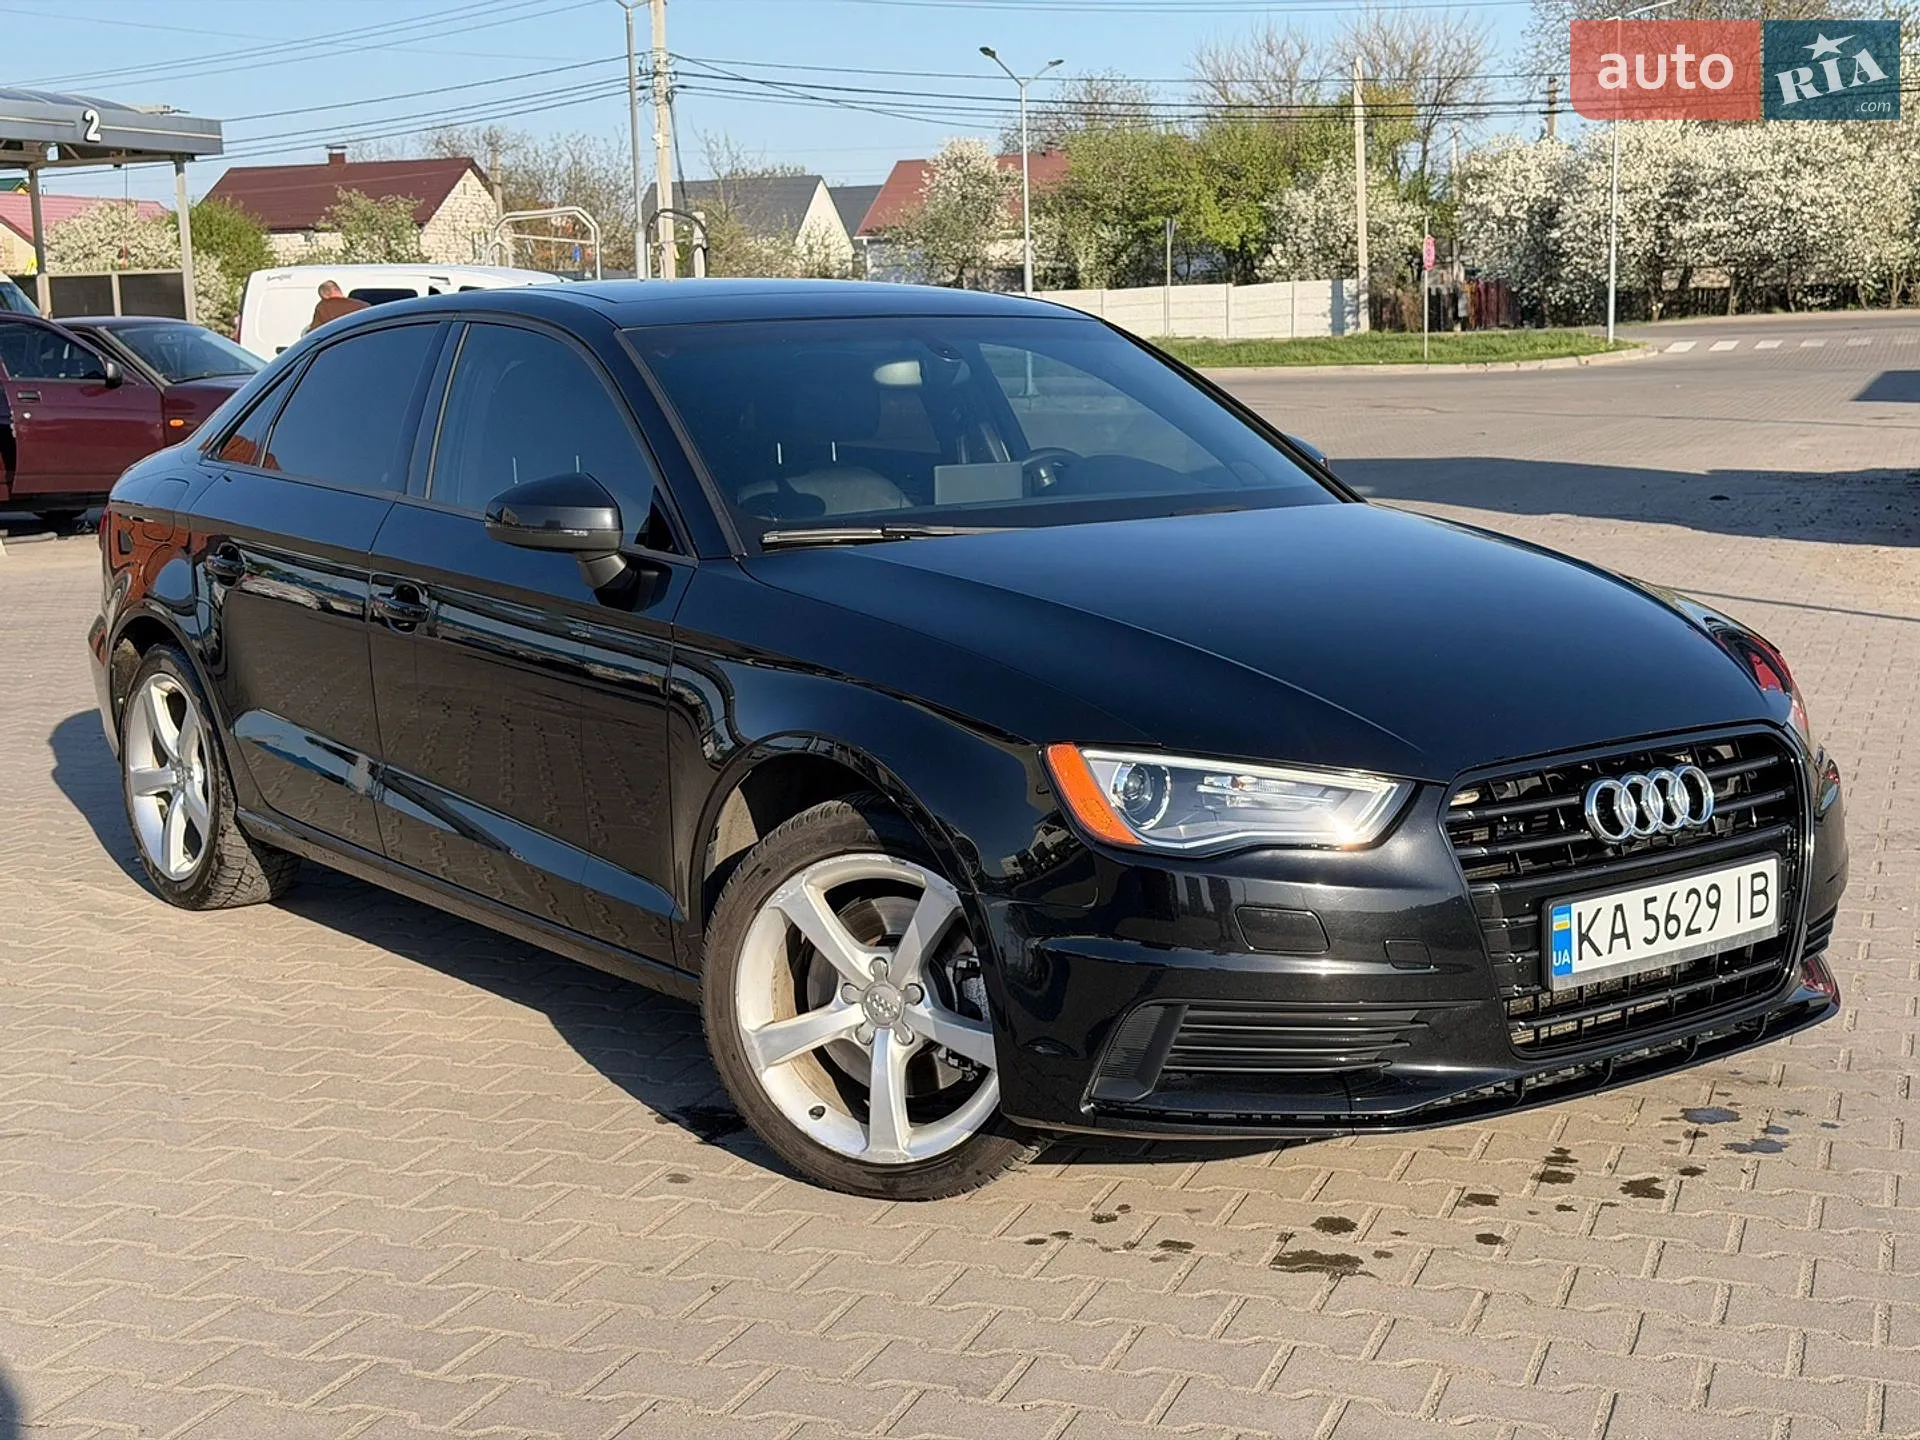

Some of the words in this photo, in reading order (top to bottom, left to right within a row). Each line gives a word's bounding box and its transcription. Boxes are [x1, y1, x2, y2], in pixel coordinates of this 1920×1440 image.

[82, 109, 101, 143] 2
[1577, 903, 1632, 961] KA
[1643, 883, 1721, 945] 5629
[1737, 872, 1769, 923] IB
[1553, 950, 1571, 967] UA
